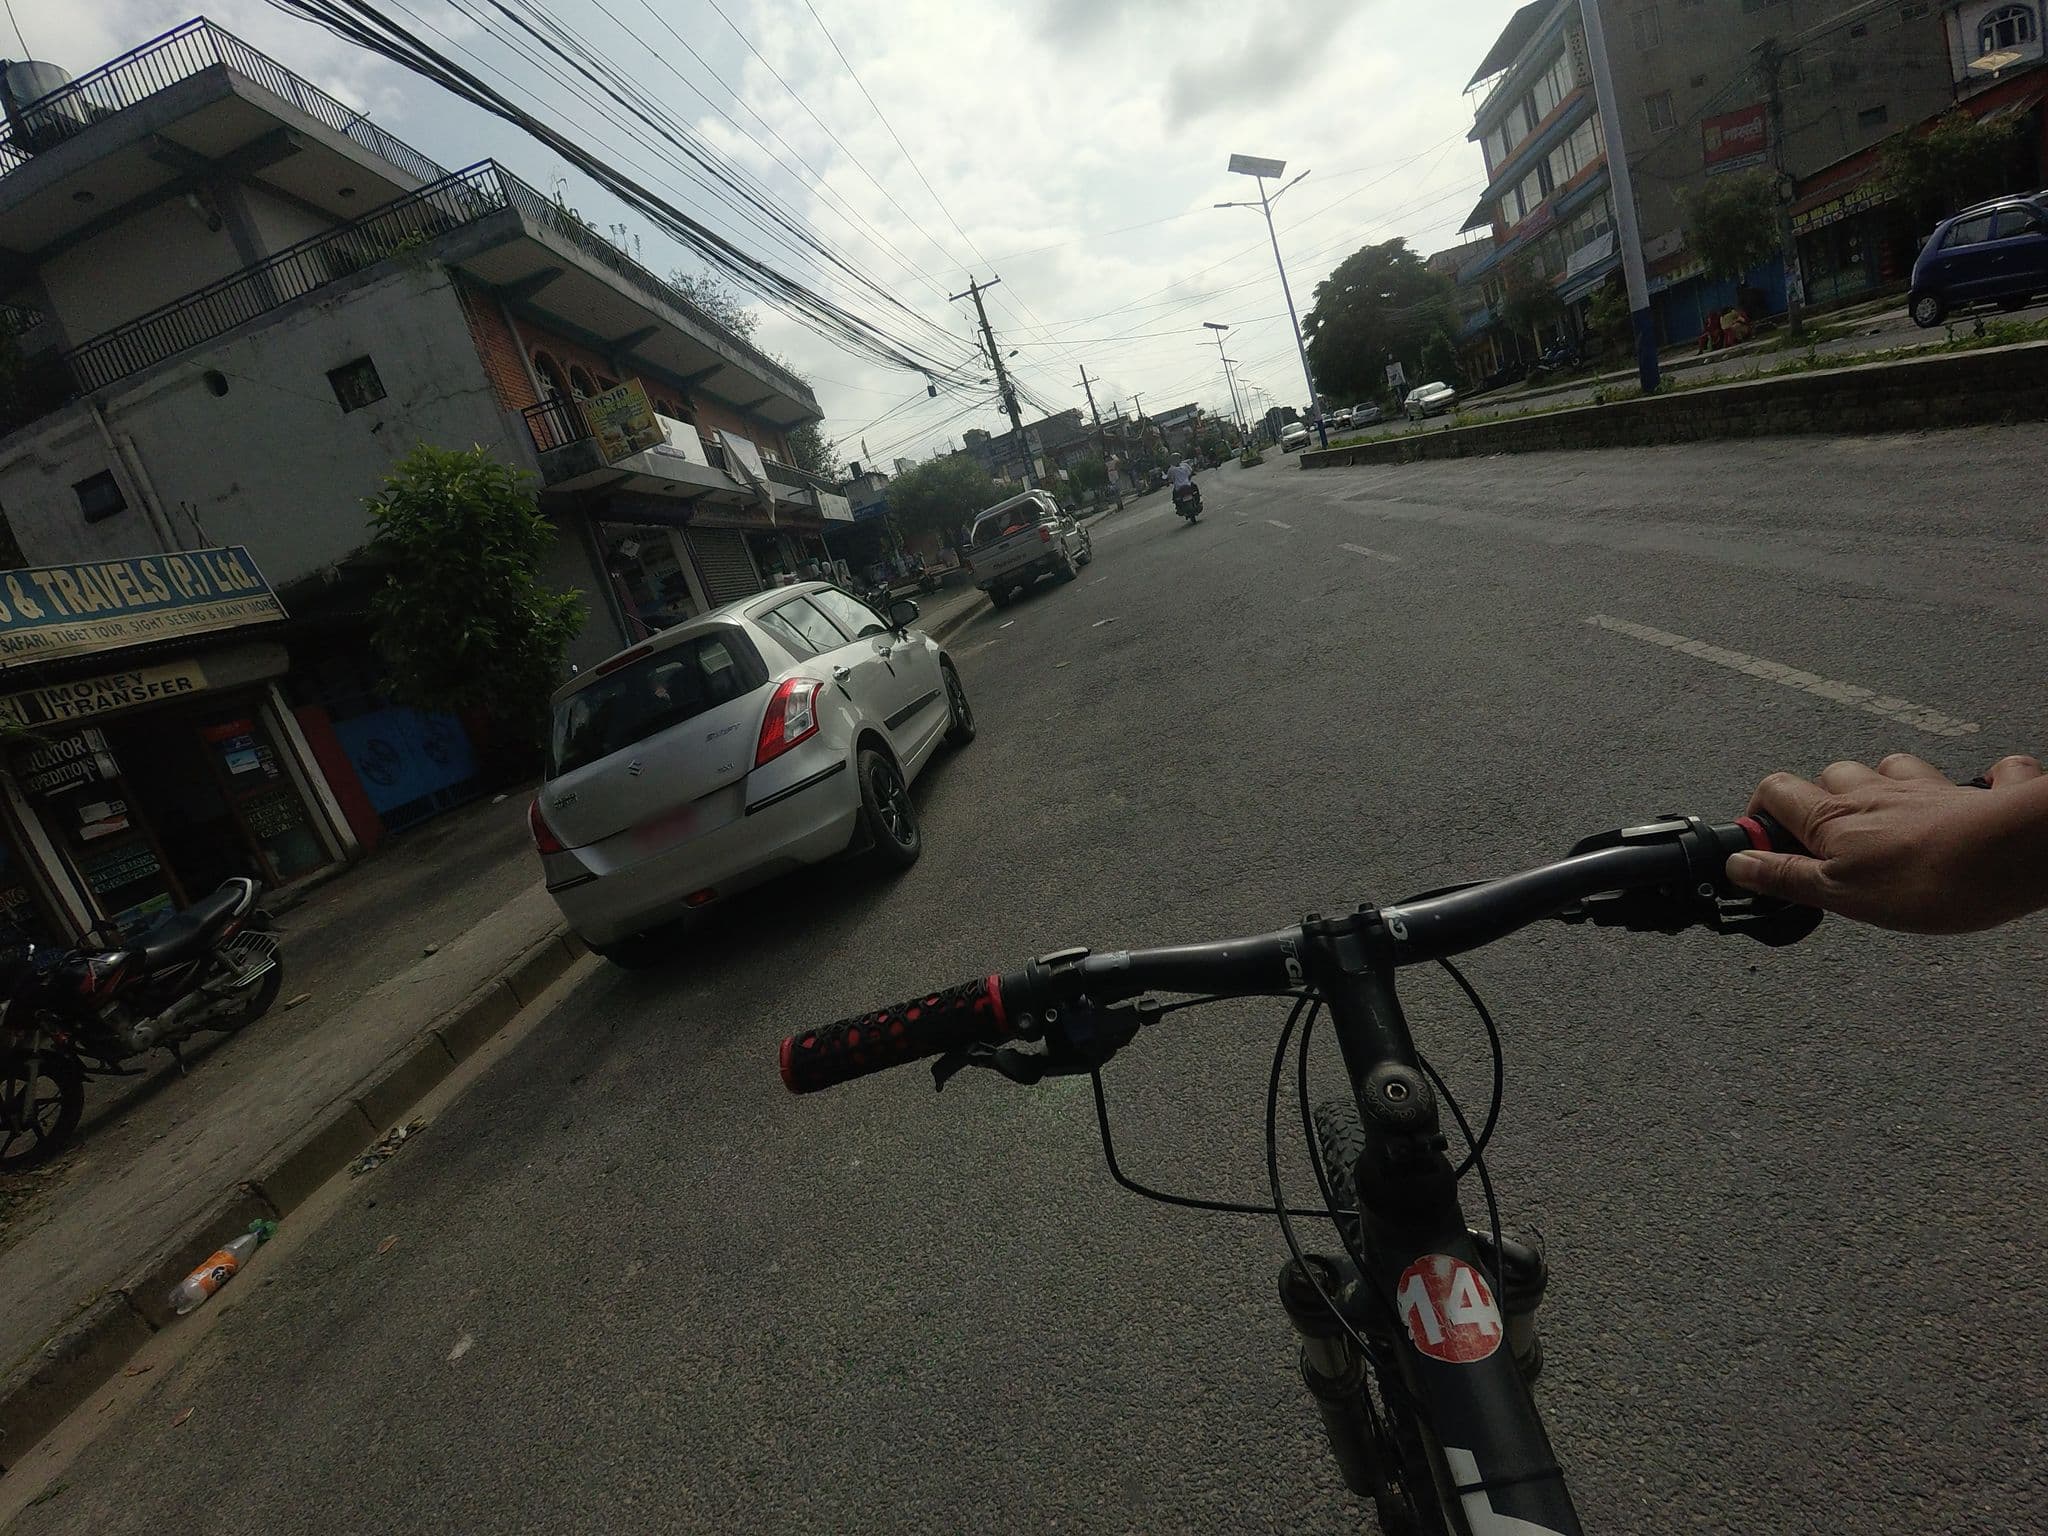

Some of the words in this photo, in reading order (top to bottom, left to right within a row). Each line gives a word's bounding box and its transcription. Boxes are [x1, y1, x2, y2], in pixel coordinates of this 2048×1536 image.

[6, 574, 46, 619] &
[30, 560, 171, 616] TRAVELS
[200, 551, 260, 593] Ltd.
[52, 628, 91, 643] TIBET
[129, 617, 163, 633] SIGHT
[165, 609, 206, 626] SEEING
[216, 602, 246, 617] MANY
[247, 599, 278, 613] MORE
[47, 673, 143, 703] MONEY
[54, 677, 192, 716] TRANSFER
[1398, 1266, 1497, 1345] 14
